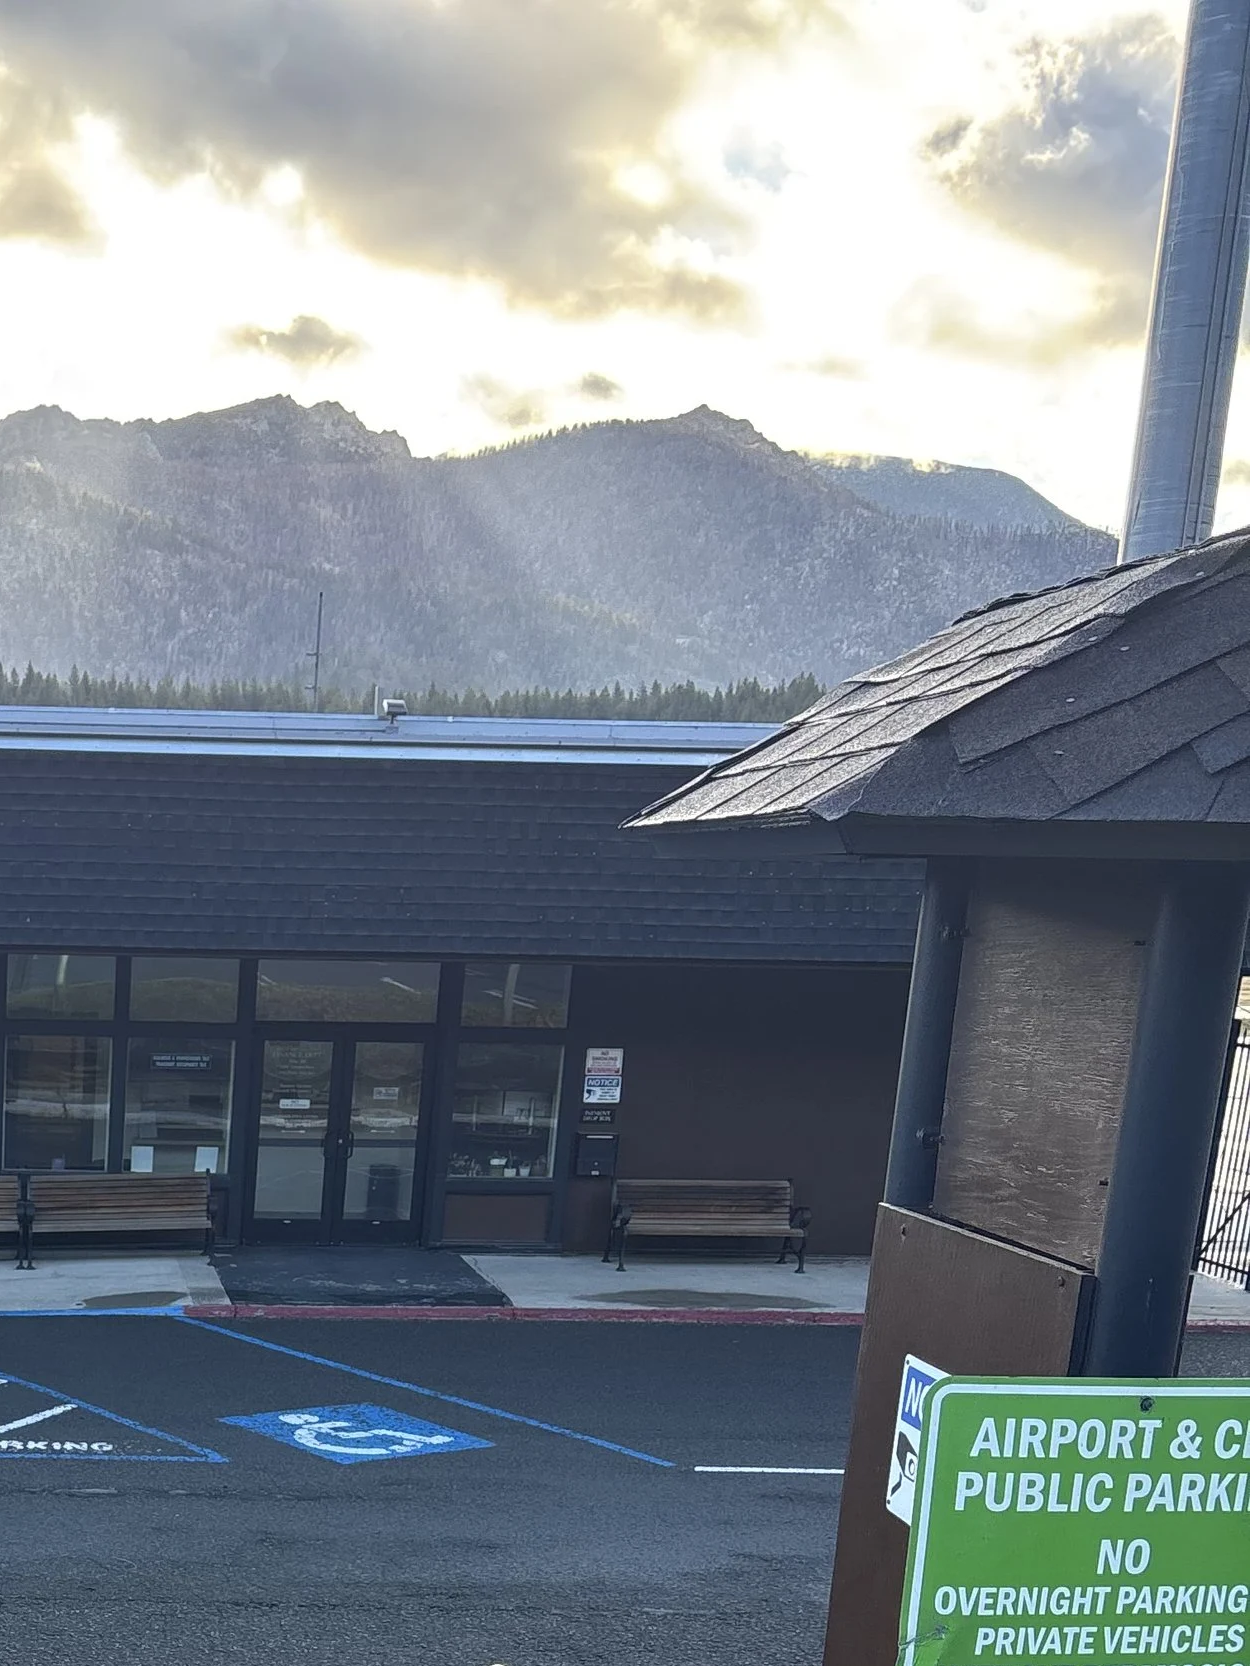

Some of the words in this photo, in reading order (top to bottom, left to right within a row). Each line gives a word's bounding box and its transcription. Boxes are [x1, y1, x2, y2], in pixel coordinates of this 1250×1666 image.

[970, 1418, 1162, 1458] AIRPORT
[1170, 1419, 1202, 1459] &
[955, 1472, 1113, 1512] PUBLIC
[1124, 1473, 1250, 1512] PARKI
[1097, 1539, 1150, 1575] NO
[935, 1587, 1111, 1616] OVERNIGHT
[1116, 1585, 1248, 1615] PARKING
[975, 1627, 1097, 1655] PRIVATE
[1104, 1625, 1245, 1653] VEHICLES
